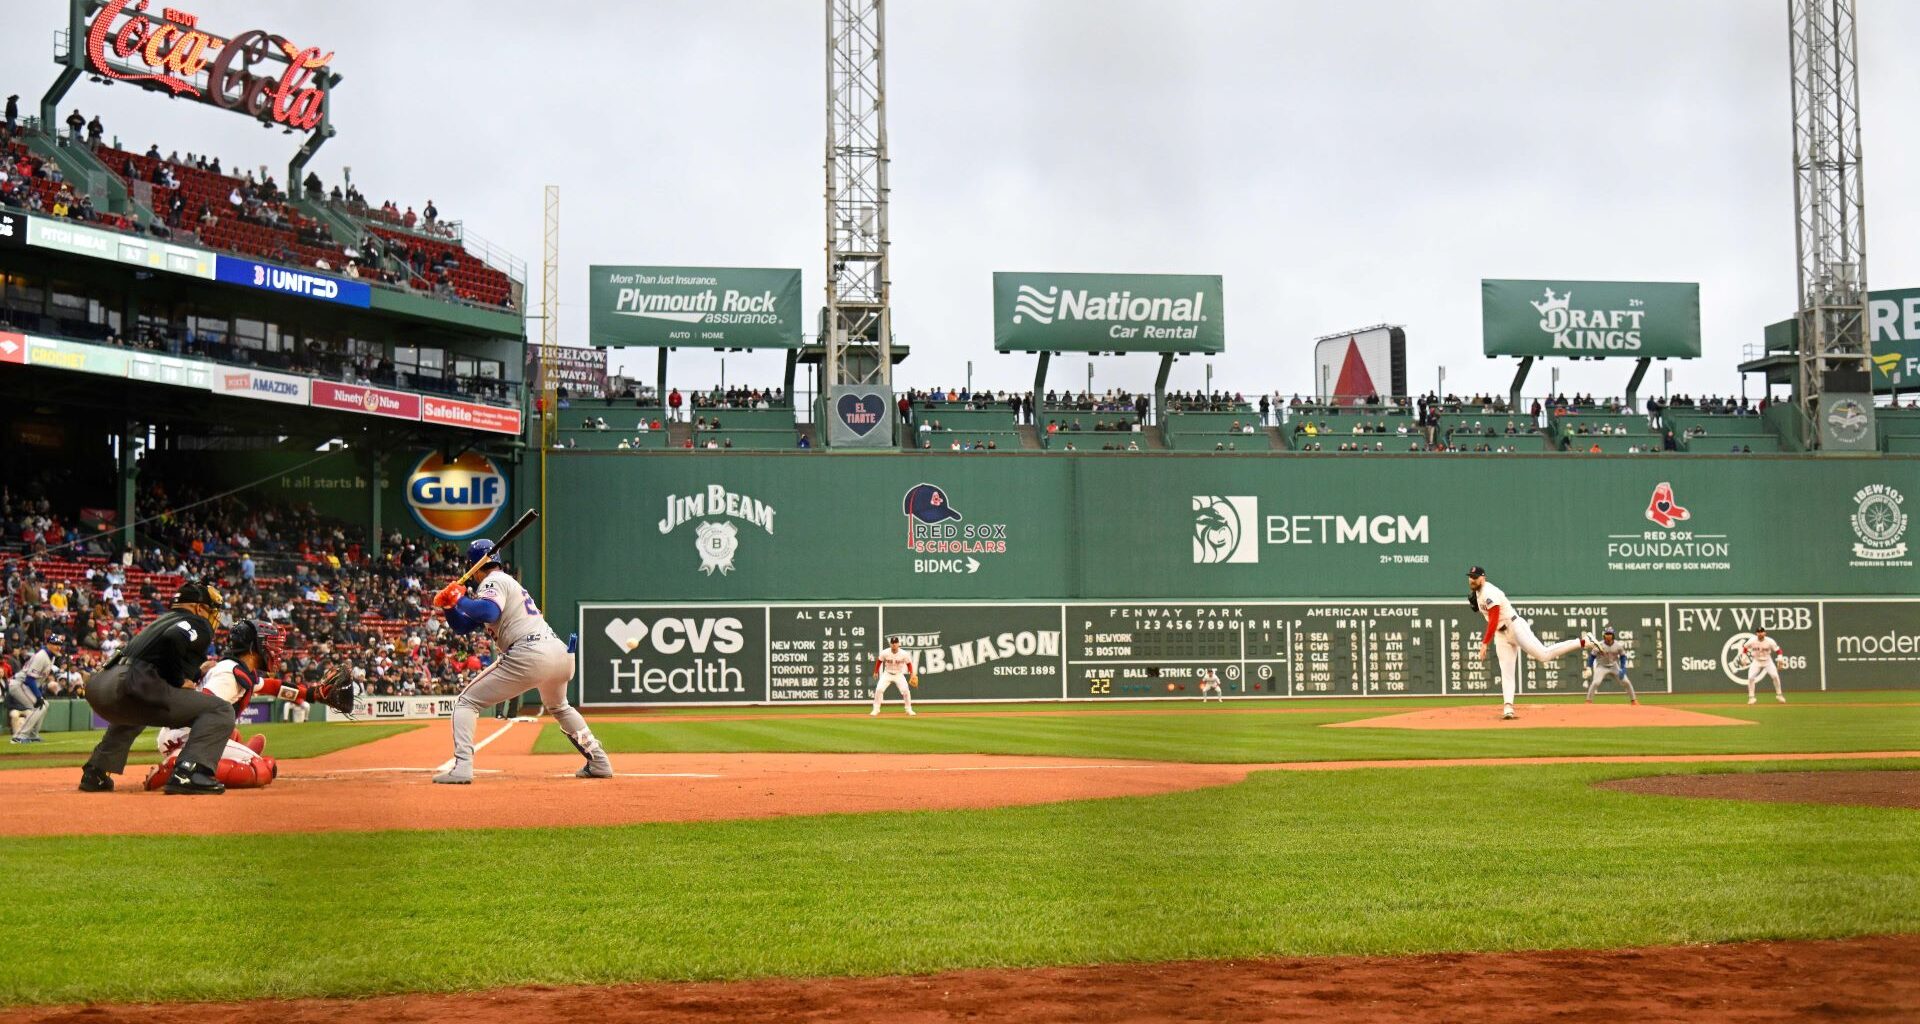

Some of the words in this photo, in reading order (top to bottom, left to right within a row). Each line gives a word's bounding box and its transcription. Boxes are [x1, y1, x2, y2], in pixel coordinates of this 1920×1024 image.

[164, 8, 199, 27] ENJOY
[273, 269, 338, 299] UNITED
[610, 274, 635, 284] More
[635, 274, 656, 284] Than
[657, 275, 674, 285] Just
[676, 275, 718, 286] Insurance.
[616, 288, 717, 313] Plymouth
[722, 290, 778, 312] Rock
[1629, 298, 1644, 307] 21+
[1058, 290, 1203, 322] National
[1540, 308, 1645, 333] DRAFT
[669, 331, 690, 339] AUTO
[1109, 325, 1139, 339] Car
[1144, 326, 1198, 340] Rental
[1552, 330, 1642, 350] KINGS
[253, 378, 299, 396] AMAZING
[334, 390, 363, 406] Ninety
[380, 397, 400, 410] Nine
[425, 401, 472, 422] Safelite
[856, 403, 866, 412] EL
[846, 413, 876, 423] TIANTE
[282, 477, 291, 487] It
[294, 477, 310, 487] all
[314, 477, 352, 488] starts
[355, 476, 389, 488] he
[412, 477, 500, 504] Gulf
[1853, 484, 1884, 505] IBEW
[1884, 486, 1904, 505] 103
[658, 494, 706, 535] JIM
[707, 484, 774, 535] BEAM
[915, 524, 957, 539] RED
[964, 524, 1007, 539] SOX
[1266, 515, 1429, 544] BETMGM
[1644, 531, 1668, 540] RED
[1670, 531, 1693, 540] SOX
[915, 540, 1006, 554] SCHOLARS
[1608, 543, 1729, 557] FOUNDATION
[1876, 549, 1902, 557] YEARS
[1380, 555, 1392, 563] 21+
[1393, 555, 1403, 563] TO
[1403, 555, 1429, 563] WAGER
[914, 559, 964, 573] BIDMC
[1608, 562, 1626, 570] THE
[1627, 562, 1651, 570] HEART
[1652, 562, 1664, 570] OF
[1665, 562, 1682, 570] RED
[1683, 562, 1699, 570] SOX
[1700, 562, 1731, 570] NATION
[797, 611, 812, 619] AL
[819, 611, 852, 619] EAST
[1110, 609, 1182, 617] FENWAY
[1197, 609, 1242, 617] PARK
[1307, 608, 1367, 616] AMERICAN
[1374, 608, 1418, 616] LEAGUE
[1564, 607, 1607, 615] LEAGUE
[1567, 619, 1577, 628] IN
[1641, 618, 1651, 627] IN
[1677, 608, 1722, 631] F.W.
[1730, 607, 1813, 631] WEBB
[1229, 620, 1238, 629] 10
[1337, 620, 1346, 628] IN
[1412, 620, 1421, 628] IN
[651, 616, 744, 655] CVS
[840, 628, 846, 636] L
[852, 627, 864, 636] GB
[1470, 632, 1482, 640] AZ
[1542, 632, 1559, 640] BAL
[916, 634, 940, 647] BUT
[1295, 633, 1303, 641] 73
[1311, 633, 1328, 641] SEA
[1385, 632, 1402, 641] LAA
[772, 641, 790, 649] NEW
[793, 641, 815, 649] YORK
[823, 641, 834, 649] 28
[838, 640, 848, 649] 19
[1311, 642, 1329, 650] CWS
[1386, 642, 1402, 650] ATH
[1085, 647, 1093, 656] 35
[1097, 647, 1131, 656] BOSTON
[1386, 652, 1402, 660] TEX
[772, 653, 807, 662] BOSTON
[823, 653, 834, 662] 25
[838, 653, 849, 662] 25
[855, 653, 861, 661] 4
[1295, 653, 1303, 661] 32
[1311, 653, 1328, 661] CLE
[1295, 663, 1303, 671] 20
[1385, 662, 1403, 670] NYY
[1467, 661, 1485, 670] COL
[1544, 661, 1560, 669] STL
[1681, 657, 1716, 671] Since
[772, 666, 814, 674] TORONTO
[823, 665, 834, 674] 23
[838, 665, 849, 674] 24
[855, 665, 861, 673] 5
[994, 667, 1027, 675] SINCE
[1031, 666, 1055, 675] 1898
[1085, 669, 1096, 678] AT
[1099, 669, 1115, 678] BAT
[1124, 669, 1147, 677] BALL
[1159, 669, 1192, 677] STRIKE
[610, 658, 745, 694] Health
[1311, 673, 1330, 681] HOU
[1389, 672, 1401, 680] SD
[1452, 672, 1460, 680] 32
[1469, 672, 1485, 680] ATL
[1546, 671, 1558, 679] KC
[772, 678, 799, 686] TAMPA
[802, 678, 818, 686] BAY
[823, 677, 835, 686] 23
[838, 677, 849, 686] 26
[855, 677, 862, 686] 6
[1090, 678, 1111, 694] 22
[1386, 682, 1404, 690] TOR
[1452, 681, 1461, 690] 32
[1467, 681, 1487, 689] WSH
[772, 690, 818, 699] BALTIMORE
[824, 690, 833, 699] 16
[838, 690, 849, 698] 32
[854, 690, 863, 698] 12
[376, 701, 404, 713] TRULY
